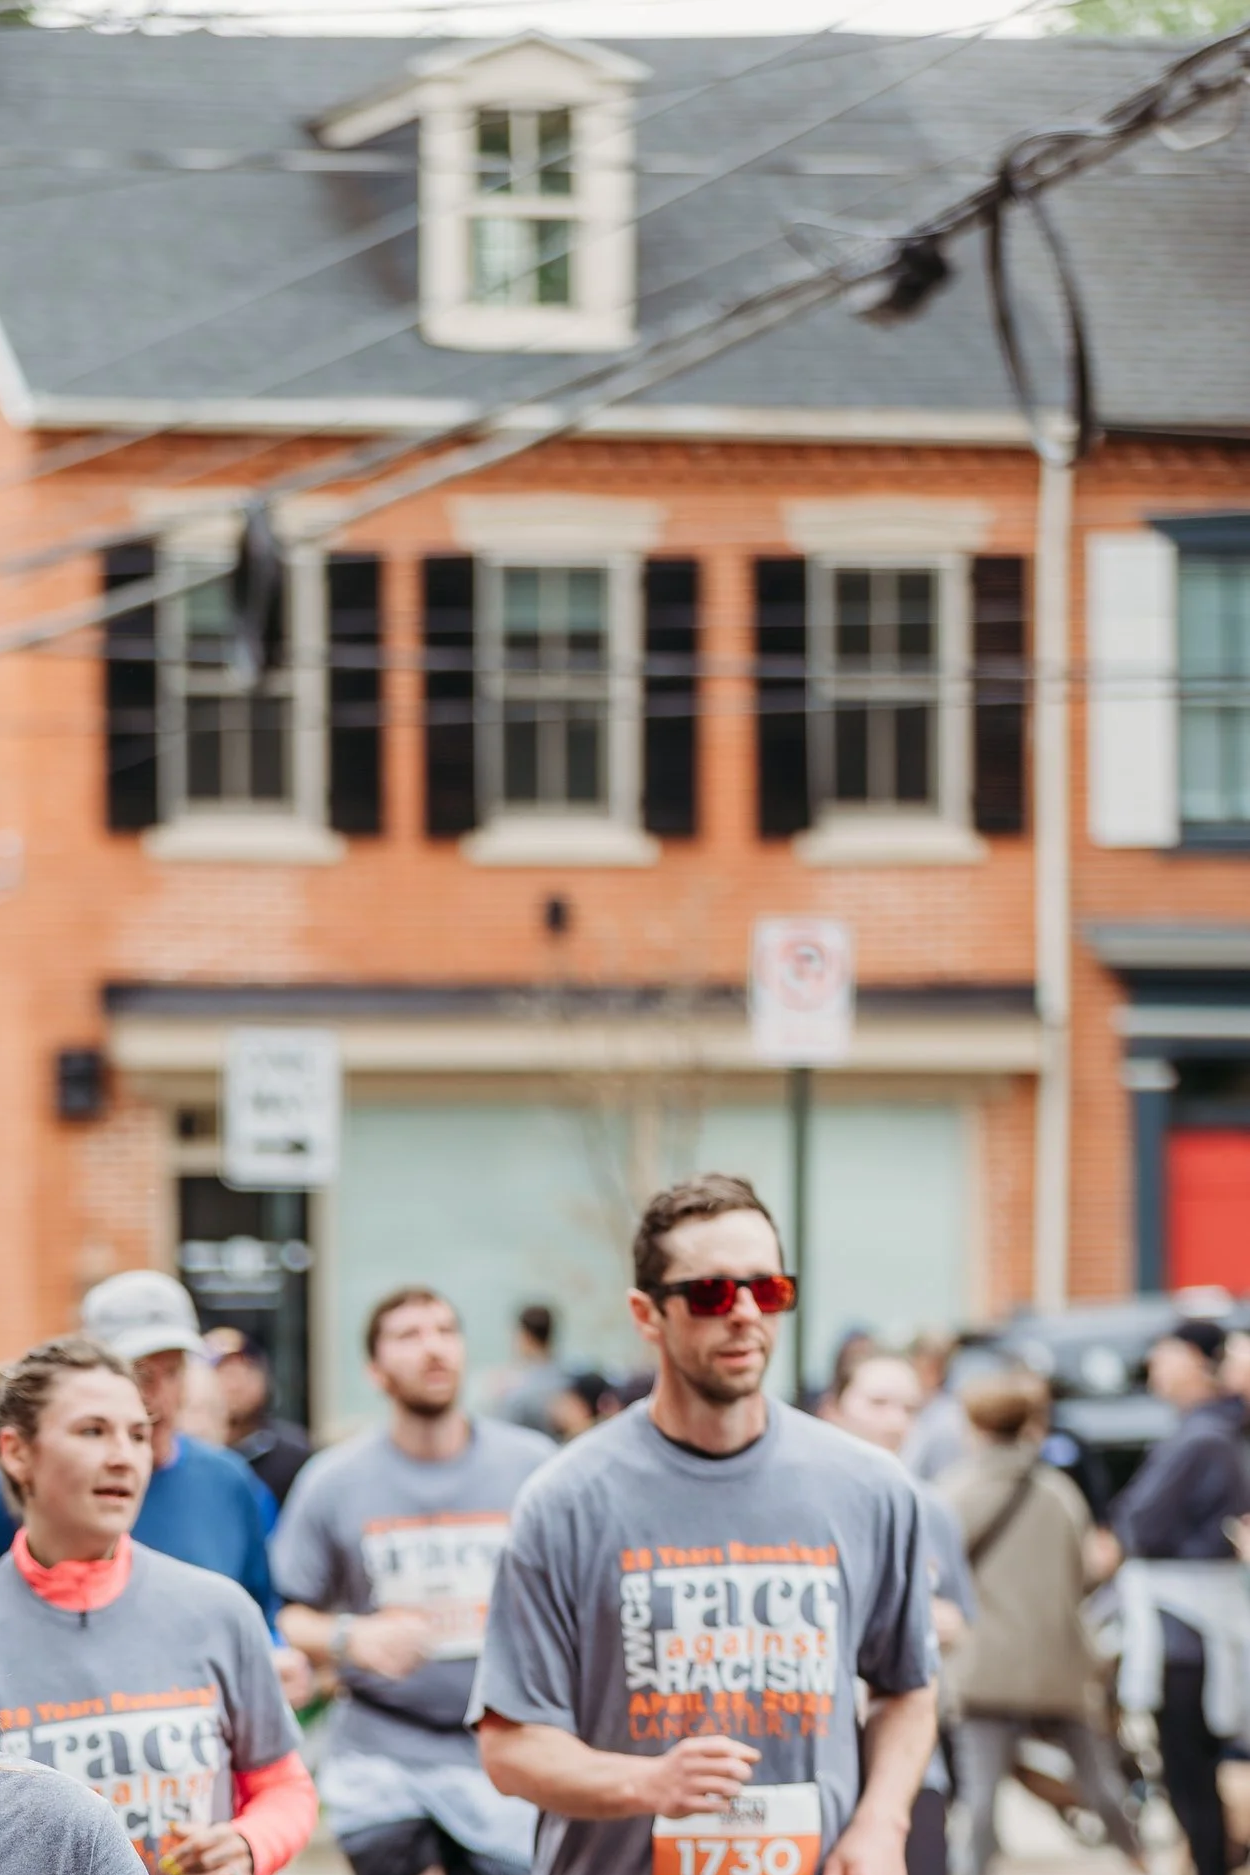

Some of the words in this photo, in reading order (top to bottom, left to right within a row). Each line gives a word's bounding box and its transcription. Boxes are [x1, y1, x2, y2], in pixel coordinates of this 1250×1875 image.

[652, 1574, 838, 1629] race
[666, 1626, 828, 1665] against
[656, 1653, 836, 1696] RACISM
